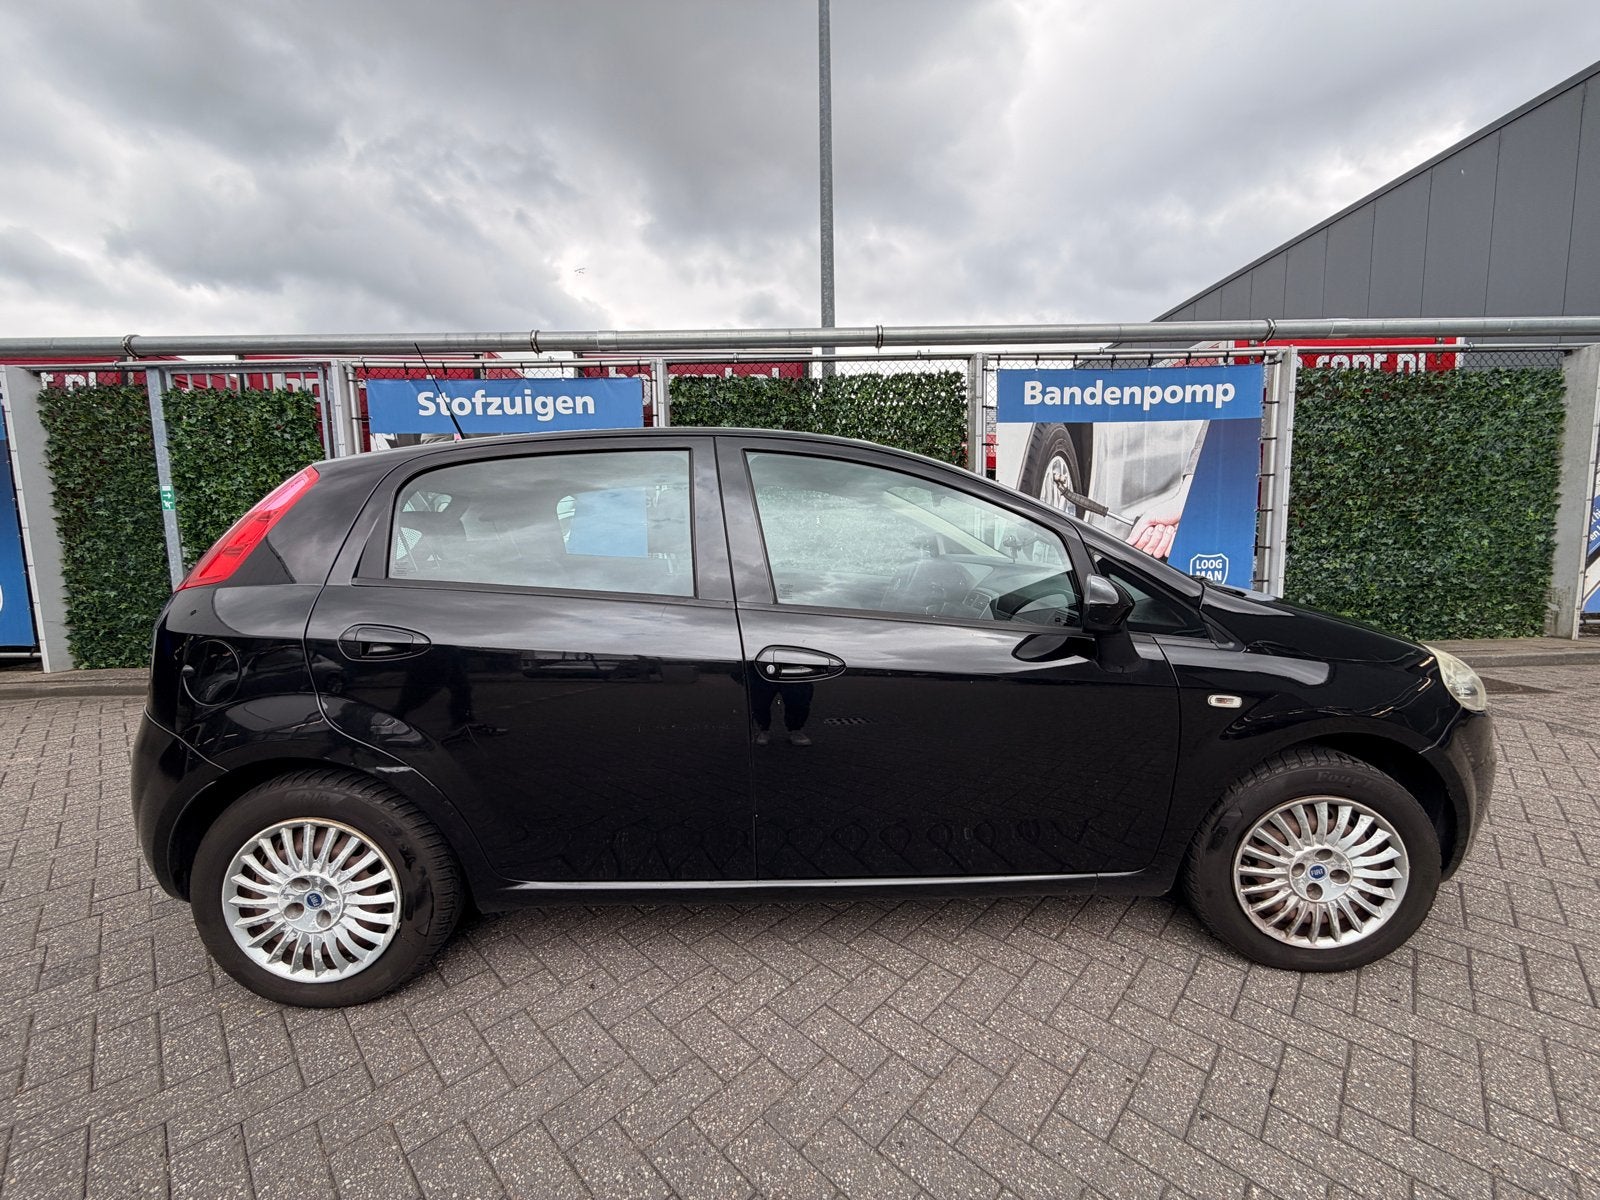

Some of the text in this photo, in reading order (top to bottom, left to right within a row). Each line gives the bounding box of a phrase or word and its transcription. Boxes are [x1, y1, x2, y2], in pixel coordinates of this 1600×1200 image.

[416, 389, 596, 421] Stofzuigen
[1023, 379, 1235, 411] Bandenpomp
[1196, 559, 1223, 569] LOOG
[1310, 868, 1324, 877] FIAT
